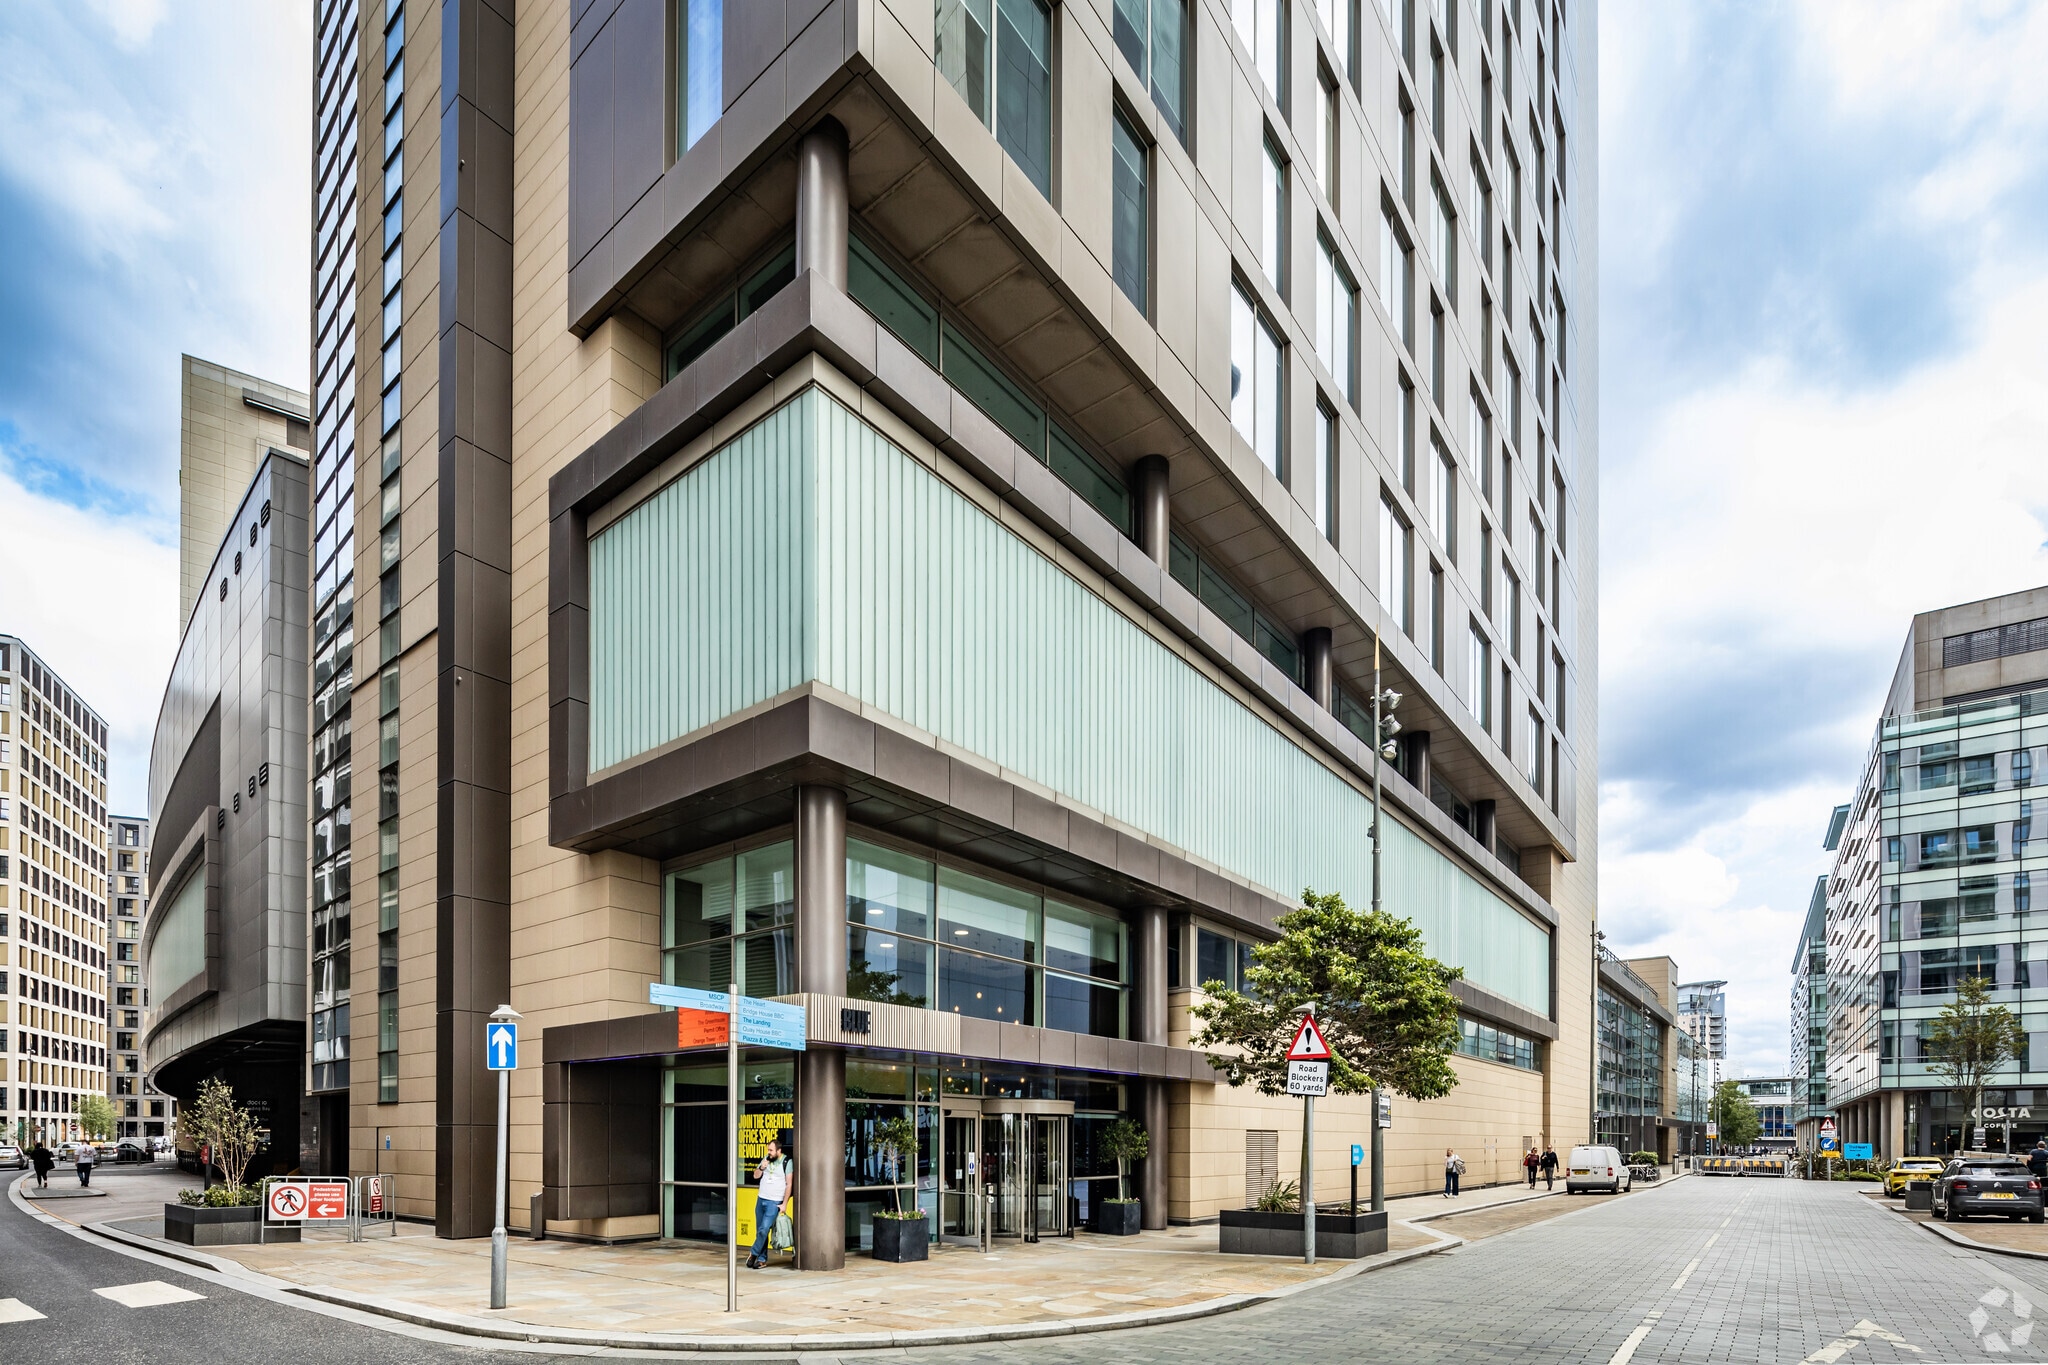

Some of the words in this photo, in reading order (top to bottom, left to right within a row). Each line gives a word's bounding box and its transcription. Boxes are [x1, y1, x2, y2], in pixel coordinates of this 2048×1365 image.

[700, 1002, 724, 1010] Broadway
[742, 1008, 758, 1016] Bridge
[759, 1010, 773, 1018] House
[774, 1012, 784, 1020] BBC
[753, 1019, 770, 1027] Landing
[841, 1008, 871, 1034] BLUE
[742, 1026, 756, 1034] Quay
[1291, 1073, 1324, 1082] Blockers
[738, 1114, 752, 1128] JOIN
[753, 1114, 765, 1128] THE
[765, 1114, 794, 1128] CREATIVE
[738, 1129, 758, 1143] OFFICE
[759, 1129, 778, 1143] SPACE
[738, 1144, 768, 1158] REVOLUT
